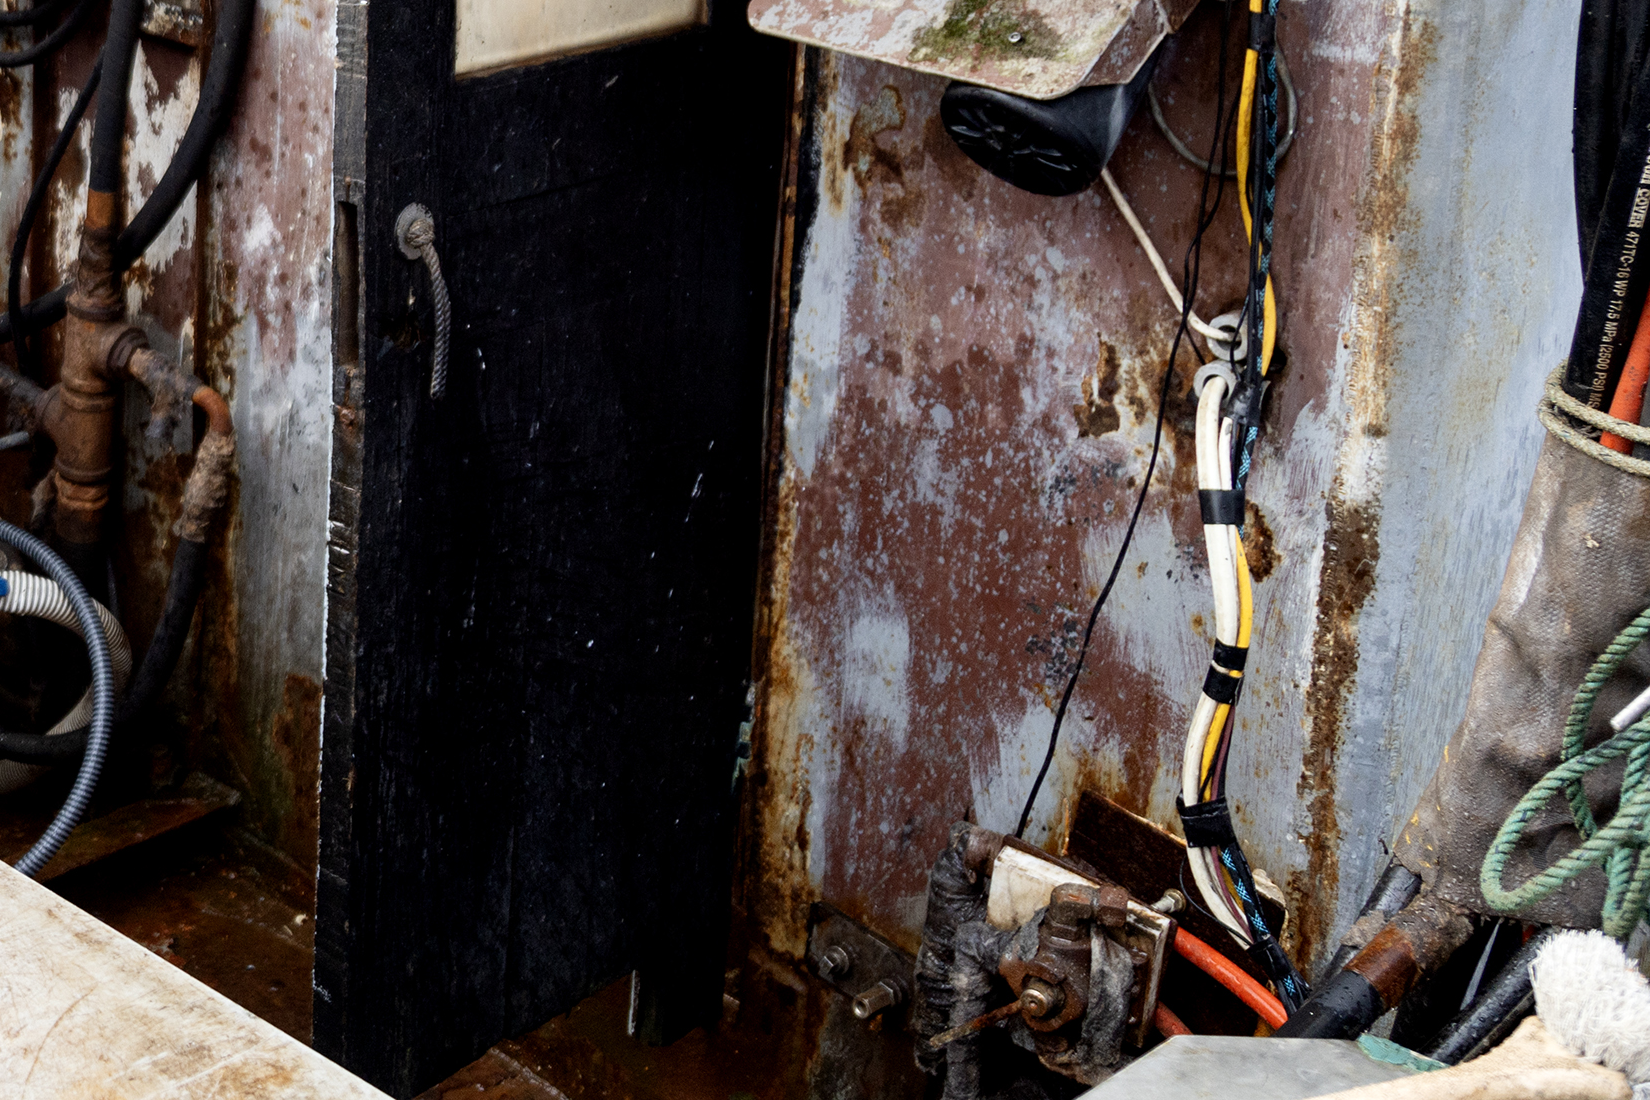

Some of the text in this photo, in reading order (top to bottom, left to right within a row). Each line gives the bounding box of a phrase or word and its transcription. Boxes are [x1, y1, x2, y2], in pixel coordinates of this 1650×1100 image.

[1615, 231, 1640, 278] 471TC-16
[1612, 280, 1629, 298] WP
[1601, 321, 1618, 343] MPa
[1596, 344, 1614, 371] (2500
[1592, 371, 1608, 391] PSI)
